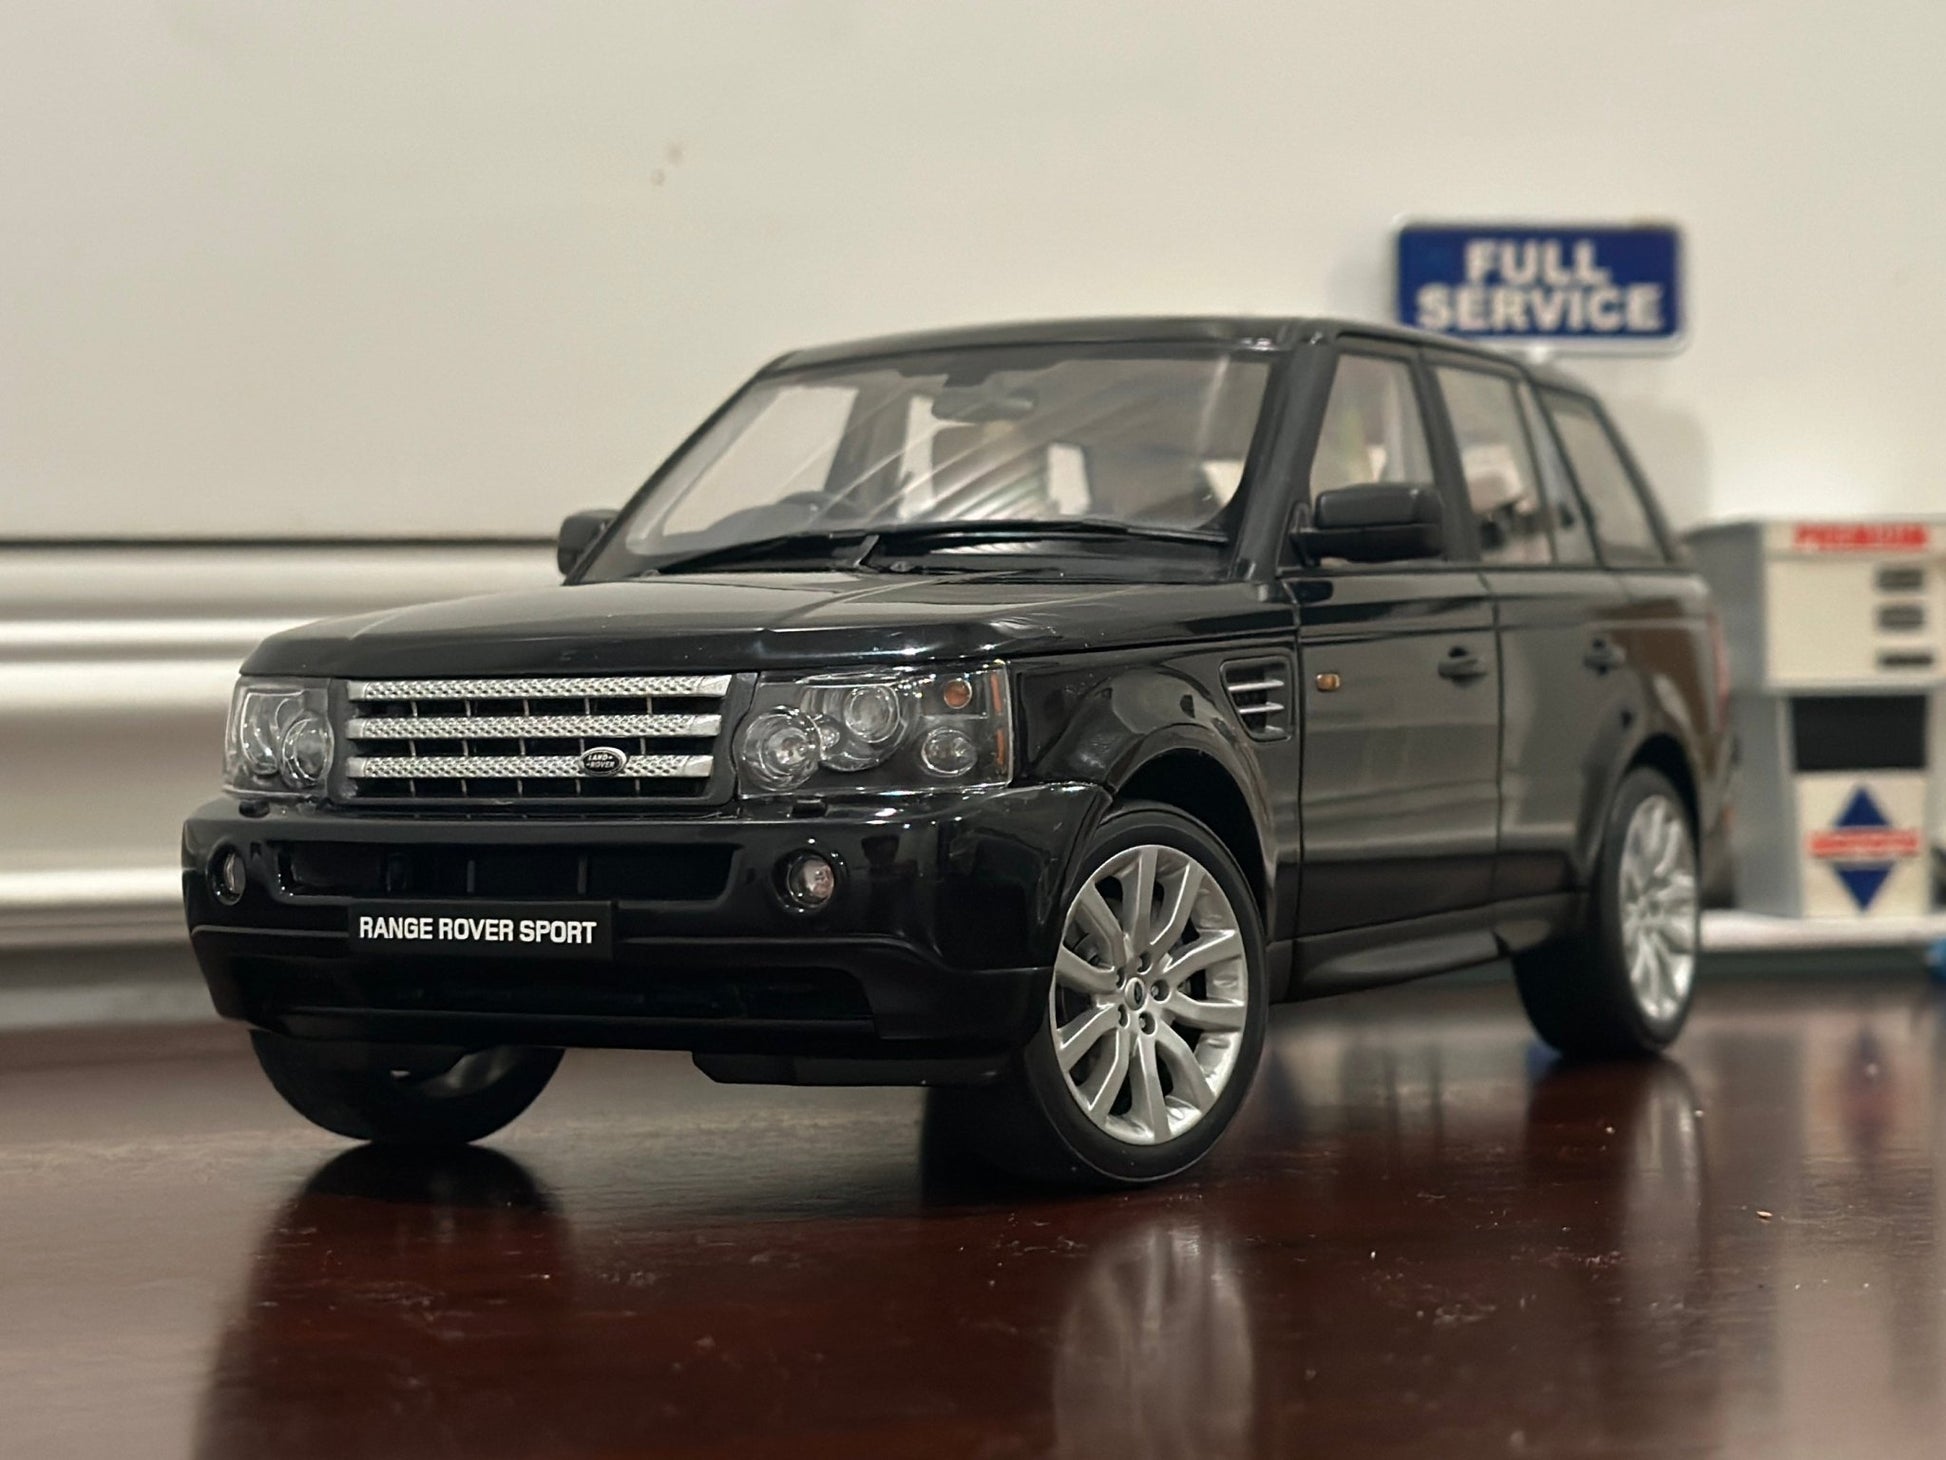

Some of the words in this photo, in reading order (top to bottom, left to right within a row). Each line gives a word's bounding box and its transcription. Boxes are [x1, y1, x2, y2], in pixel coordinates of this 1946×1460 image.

[1464, 239, 1611, 285] FULL
[1417, 283, 1664, 332] SERVICE
[588, 753, 609, 761] LAND
[590, 761, 615, 769] ROVER
[359, 916, 434, 940] RANGE
[438, 917, 514, 942] ROVER
[518, 919, 597, 944] SPORT
